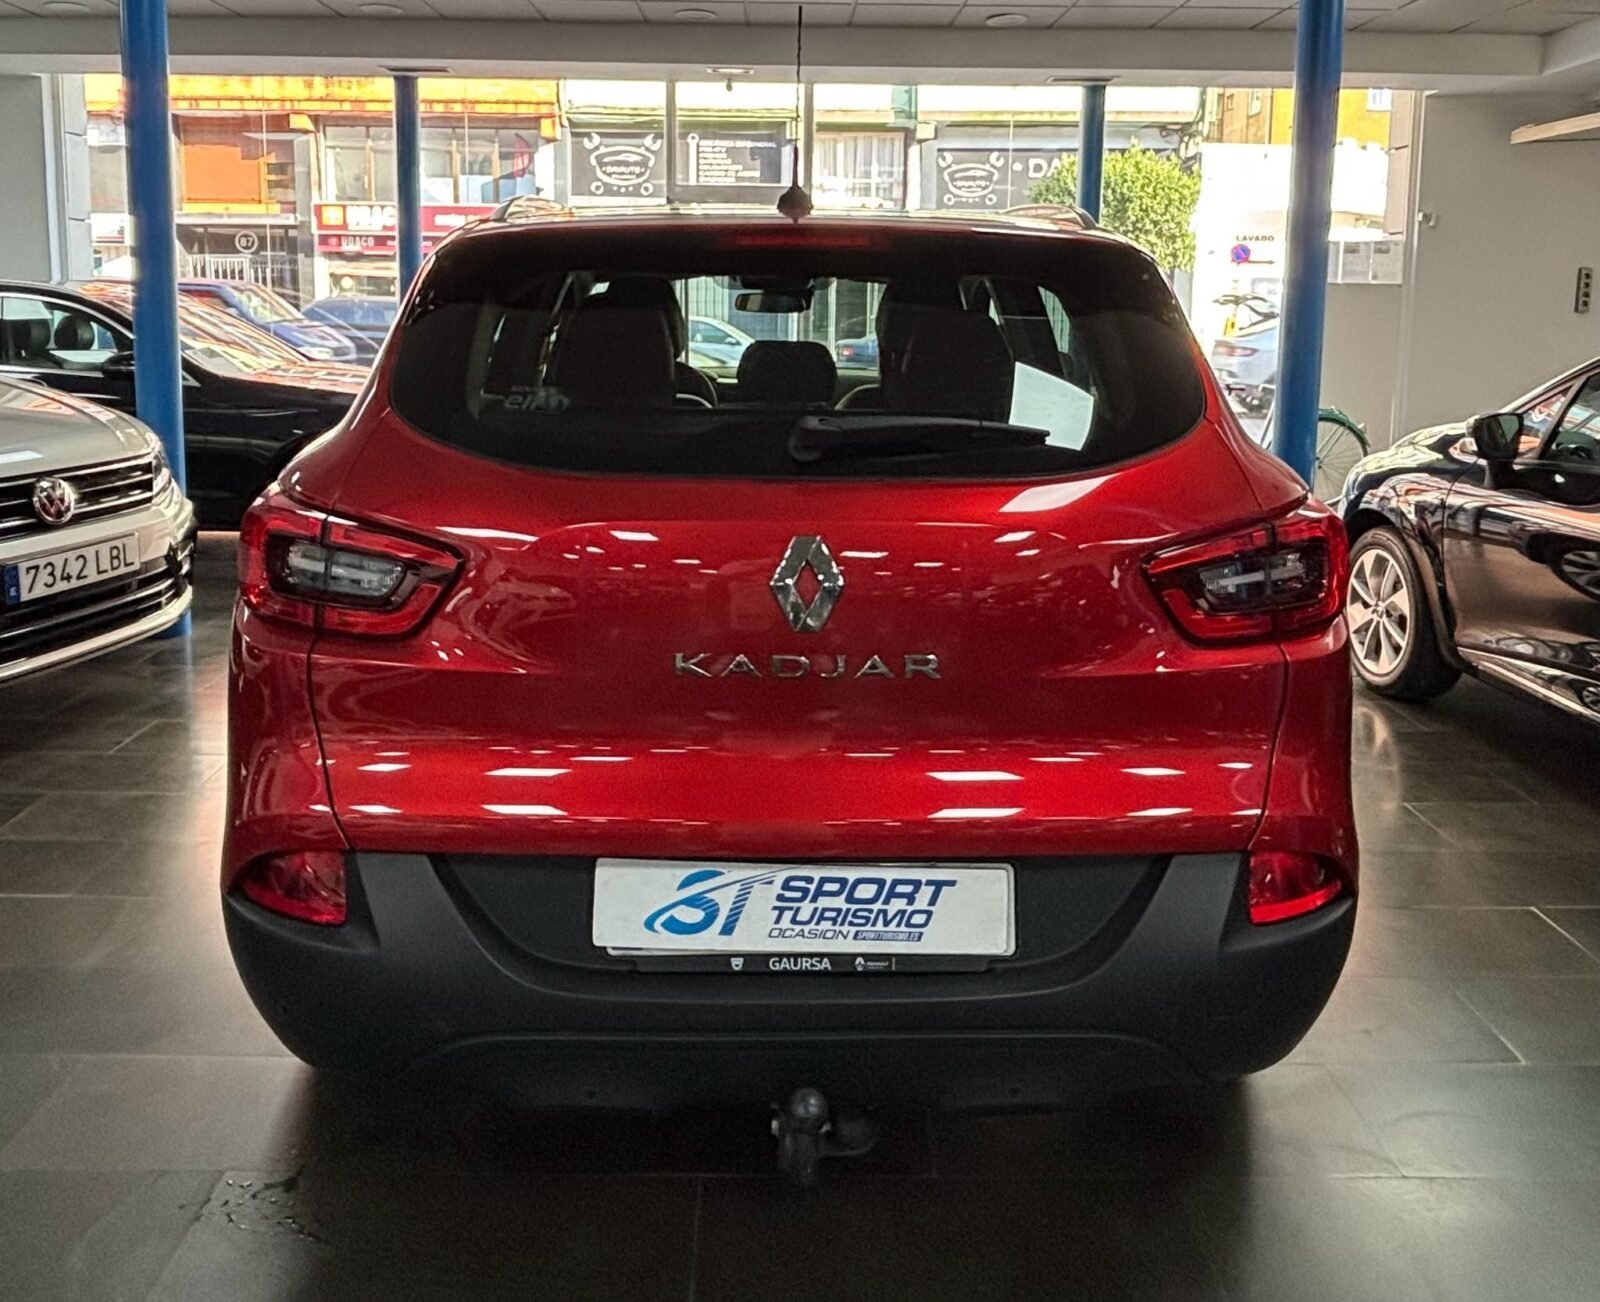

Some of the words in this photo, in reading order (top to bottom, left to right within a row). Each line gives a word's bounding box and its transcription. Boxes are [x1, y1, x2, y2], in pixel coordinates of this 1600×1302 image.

[240, 236, 254, 247] 87
[25, 553, 88, 595] 7342
[95, 542, 135, 576] LBL
[674, 652, 942, 680] KADJAR
[775, 874, 958, 907] SPORT
[770, 906, 934, 930] TURISMO
[767, 927, 851, 941] OCASION
[768, 957, 832, 971] GAURSA
